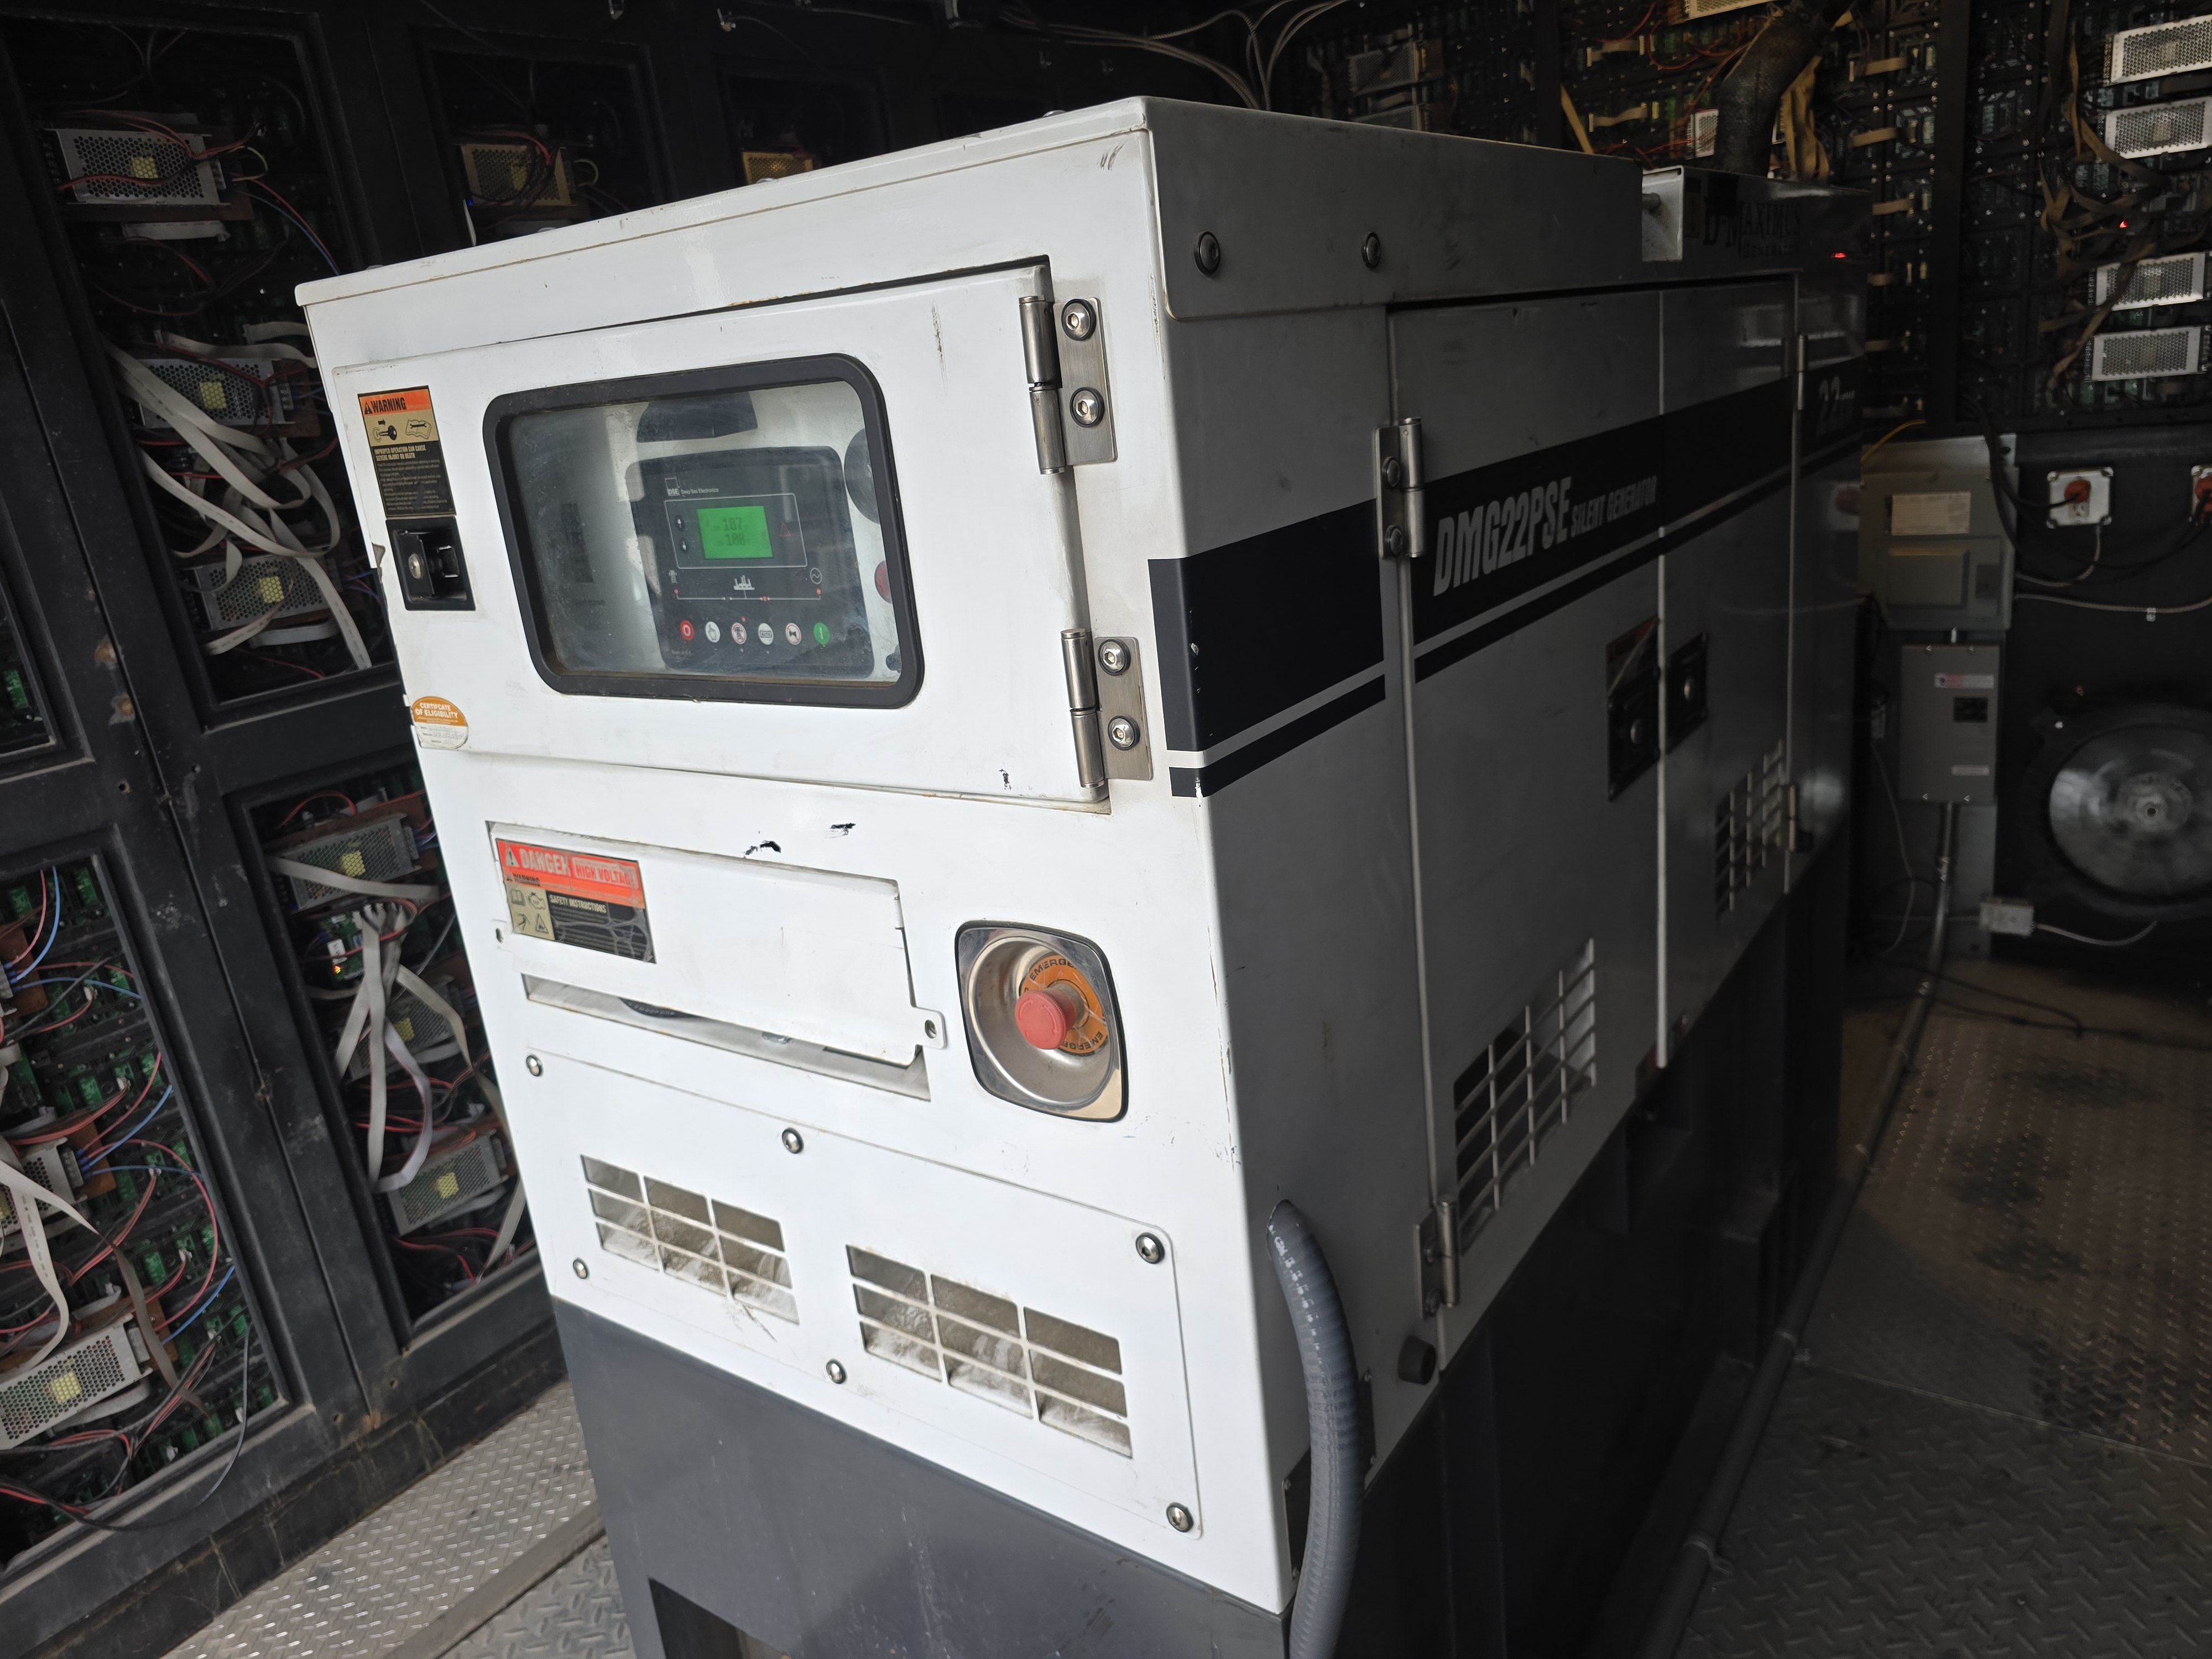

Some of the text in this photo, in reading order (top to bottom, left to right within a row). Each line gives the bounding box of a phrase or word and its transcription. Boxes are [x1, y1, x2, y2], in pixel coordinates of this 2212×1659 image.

[371, 397, 406, 413] WARNING
[1433, 475, 1657, 597] DMG22PSE SILENT GENERATOR
[424, 709, 458, 718] ELIGIBILITY
[576, 864, 597, 879] HIGH
[549, 894, 607, 914] SAFETY INSTRUCTIONS
